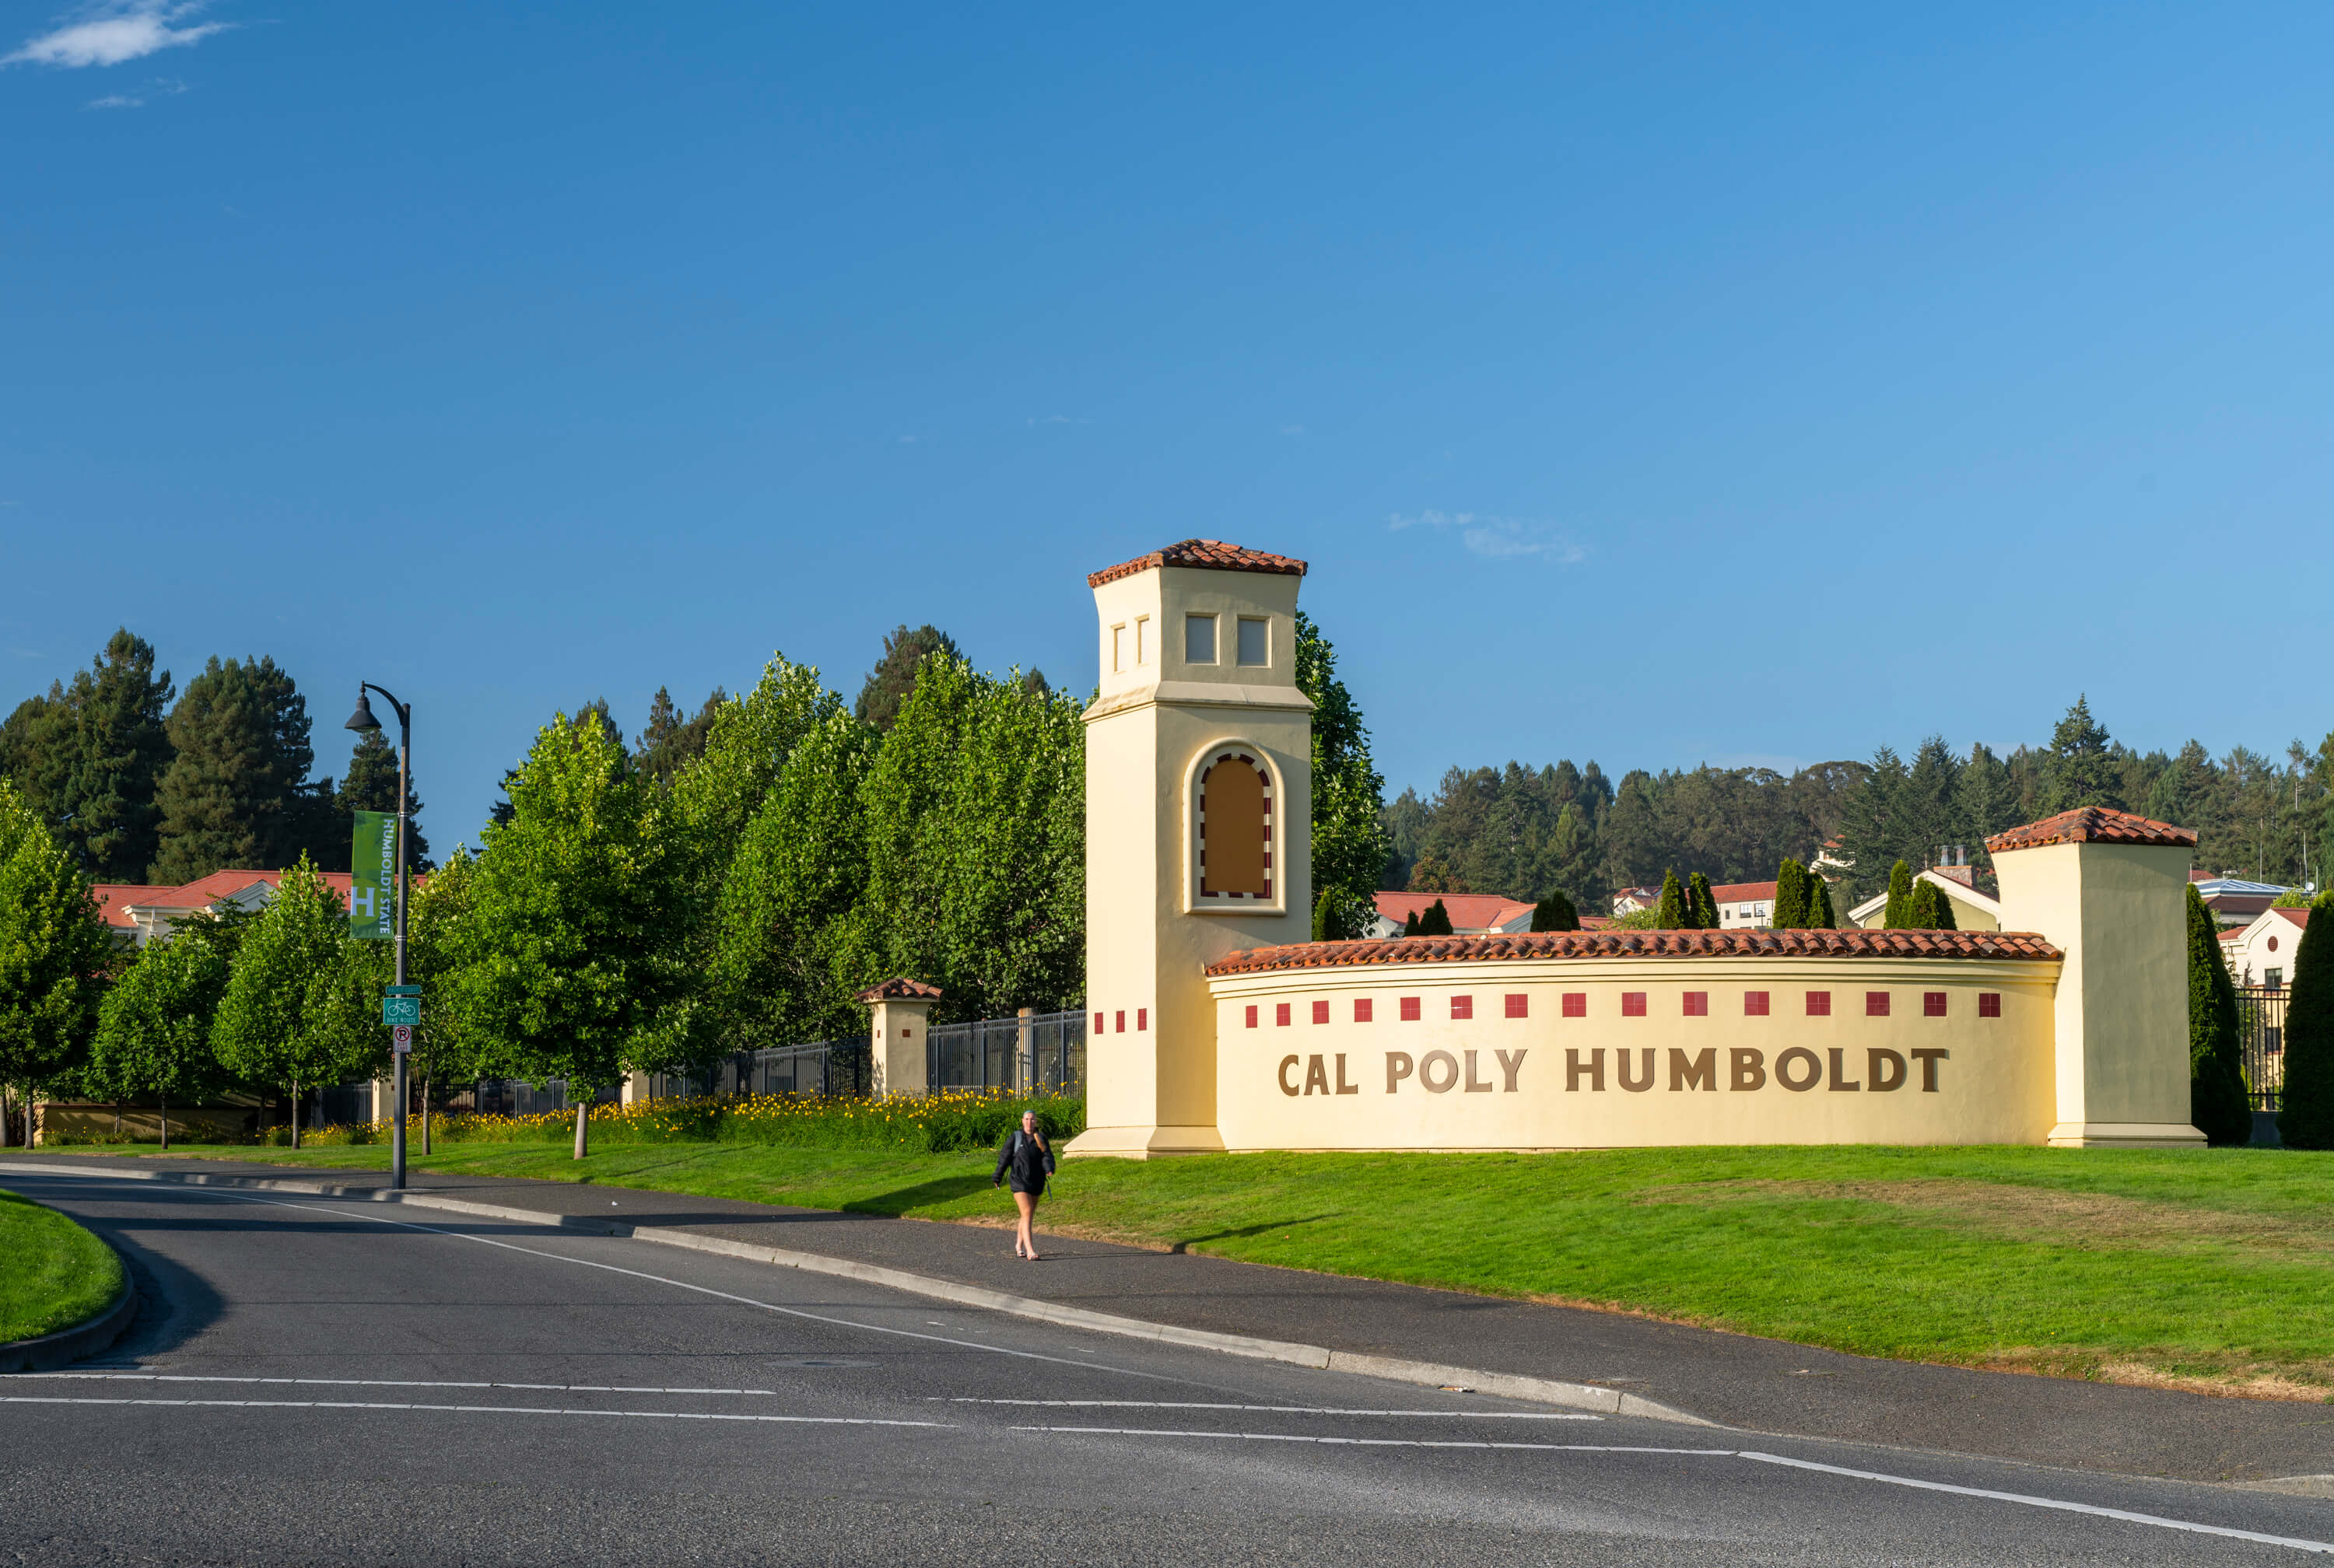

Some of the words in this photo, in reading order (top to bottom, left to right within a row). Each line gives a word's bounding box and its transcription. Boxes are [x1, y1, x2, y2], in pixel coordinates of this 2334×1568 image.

[380, 819, 394, 895] HUMBOLDT
[351, 887, 375, 917] H
[379, 898, 391, 934] STATE
[1277, 1052, 1358, 1097] CAL
[1385, 1048, 1529, 1094] POLY
[1565, 1047, 1950, 1092] HUMBOLDT
